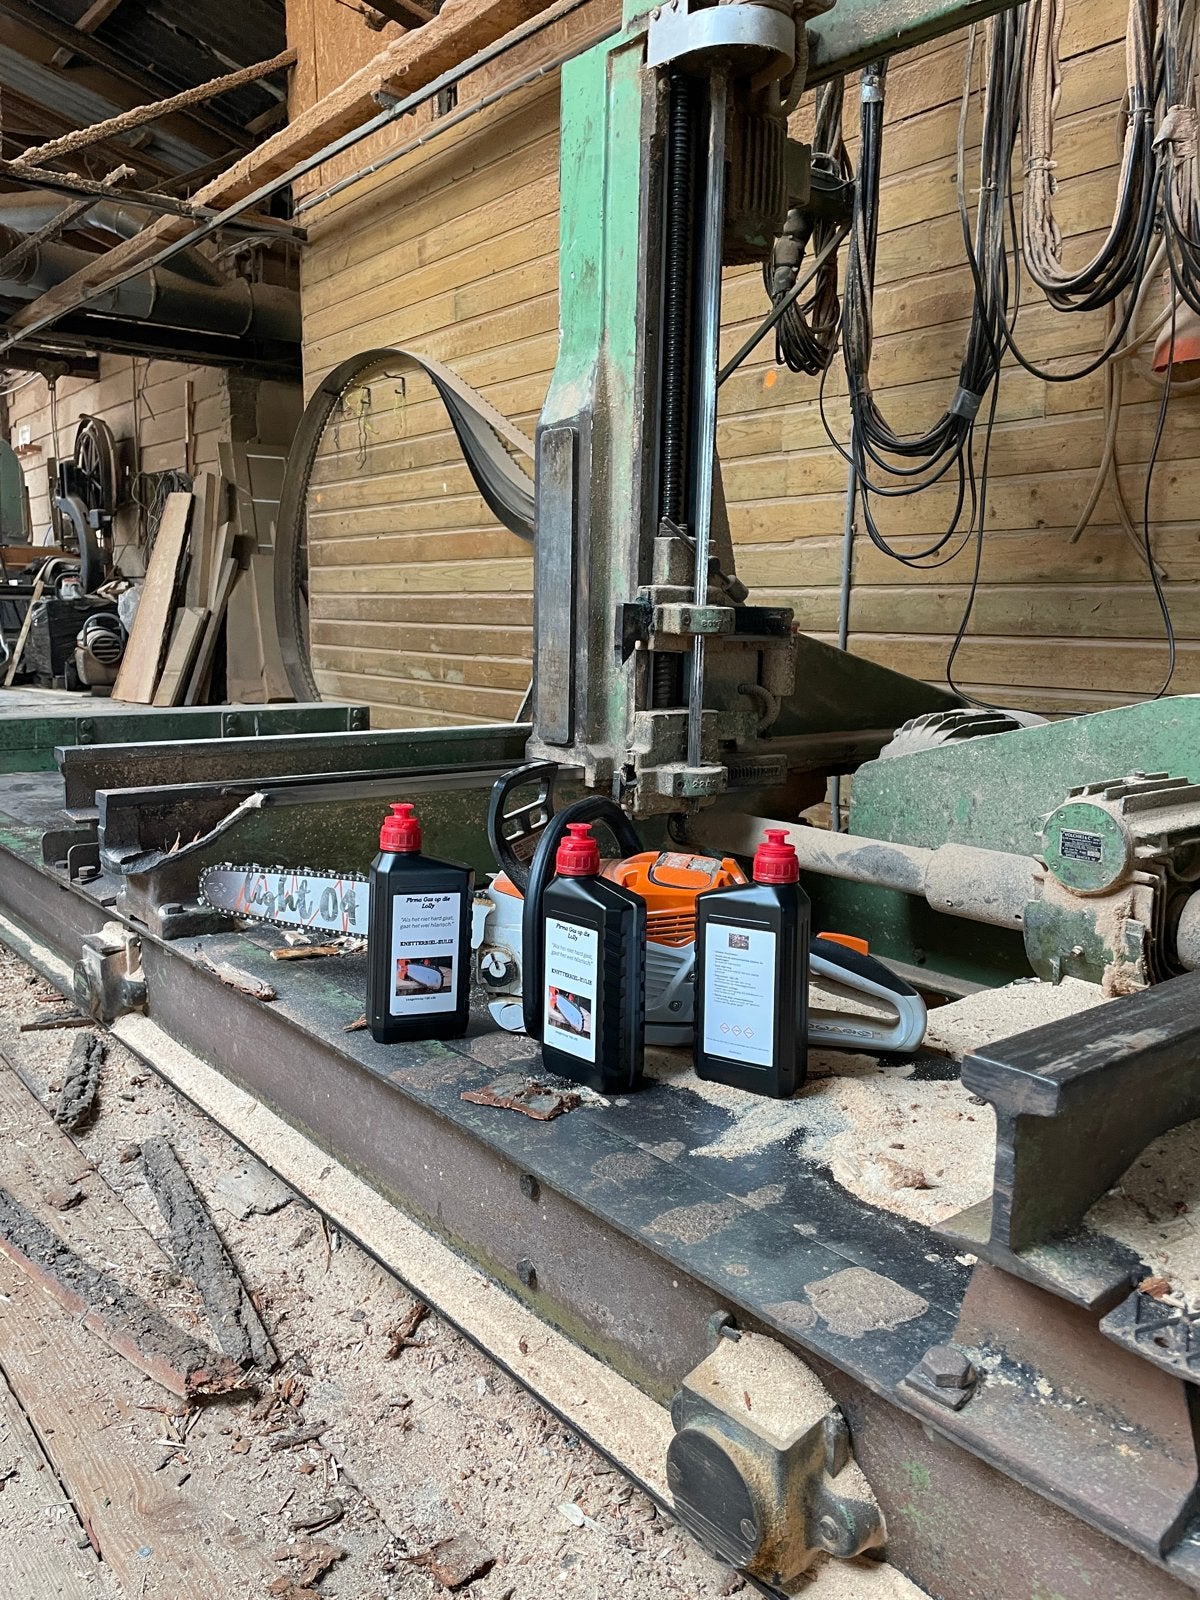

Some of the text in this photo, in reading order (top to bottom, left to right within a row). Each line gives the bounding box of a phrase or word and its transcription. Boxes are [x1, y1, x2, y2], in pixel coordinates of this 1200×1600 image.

[556, 923, 568, 931] Firma
[569, 926, 577, 934] Gas
[568, 933, 578, 941] Lolly
